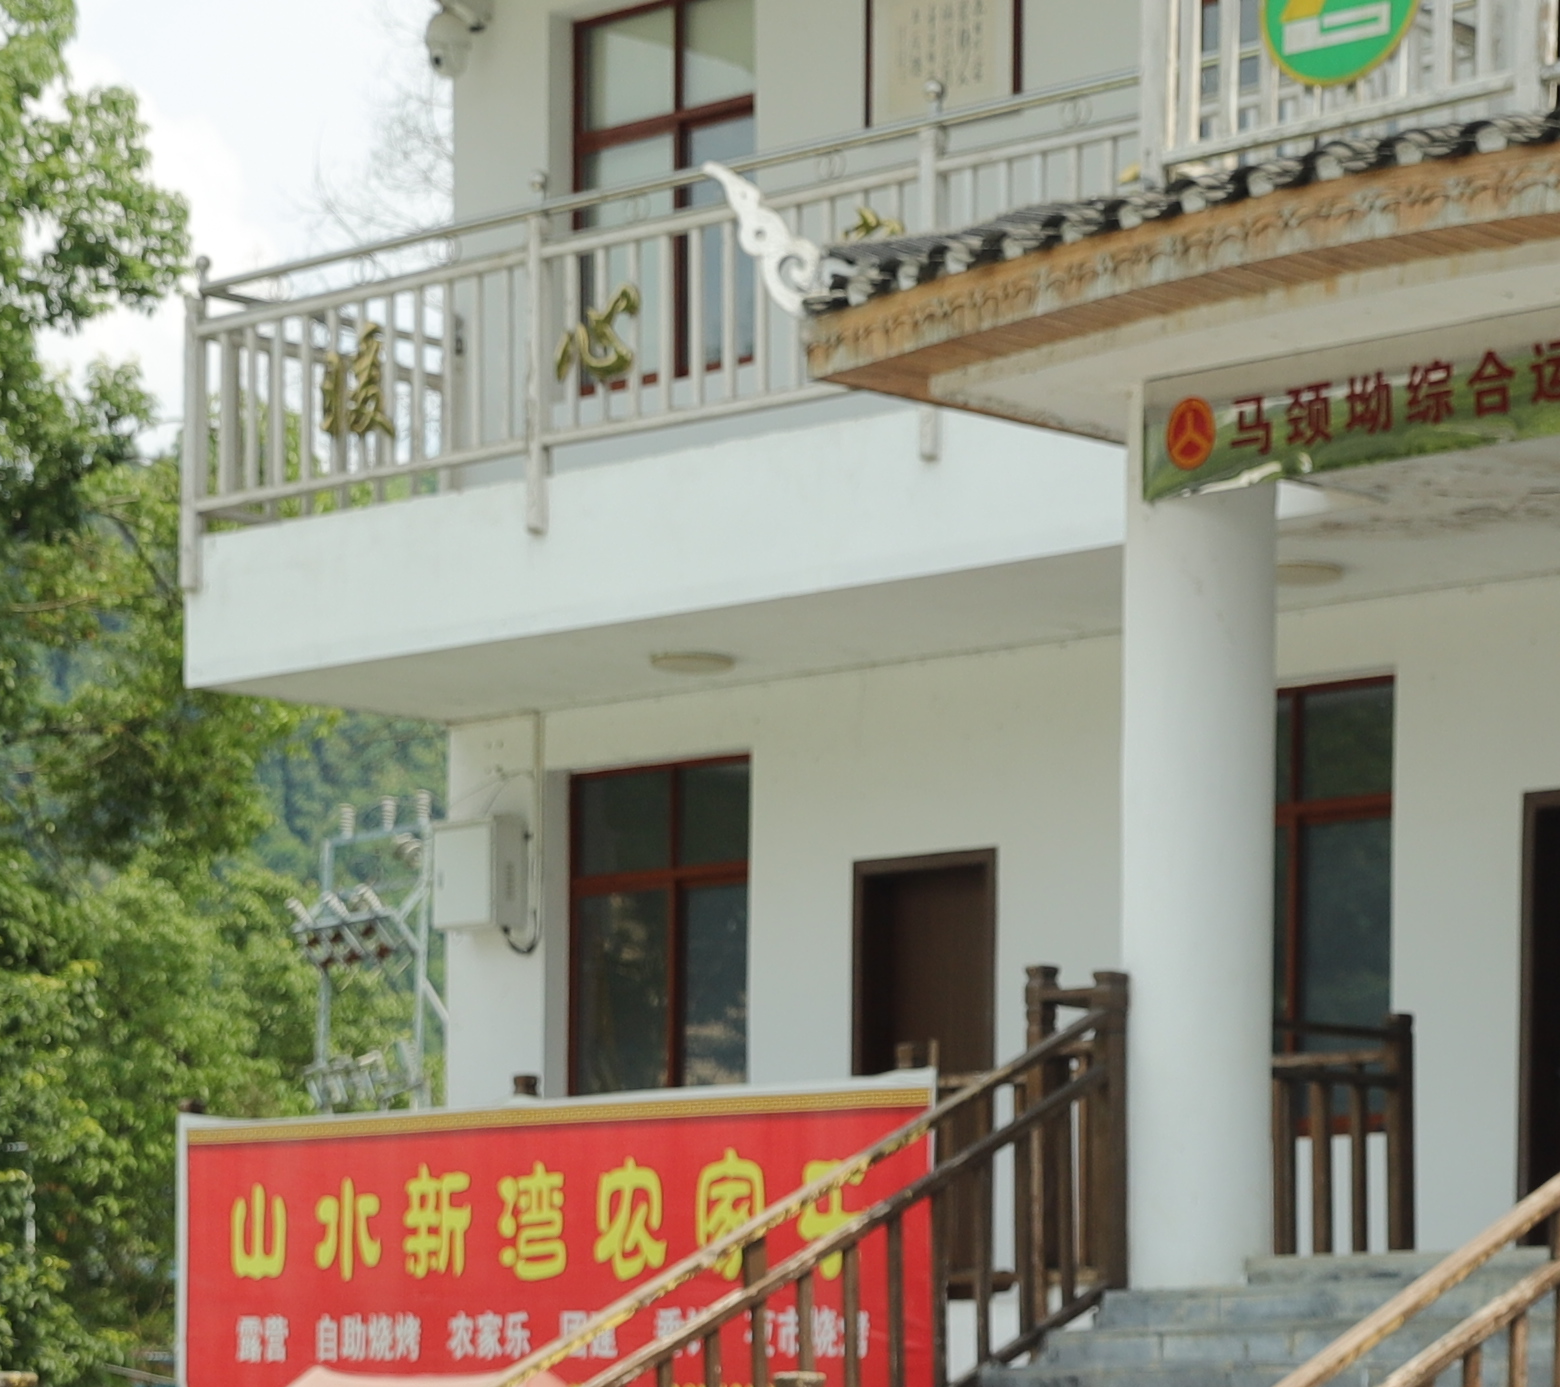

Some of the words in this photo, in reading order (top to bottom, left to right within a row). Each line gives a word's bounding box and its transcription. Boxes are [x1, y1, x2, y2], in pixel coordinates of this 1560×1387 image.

[236, 1314, 289, 1362] 露营
[315, 1311, 421, 1362] 自助烧烤
[447, 1310, 531, 1359] 农家乐
